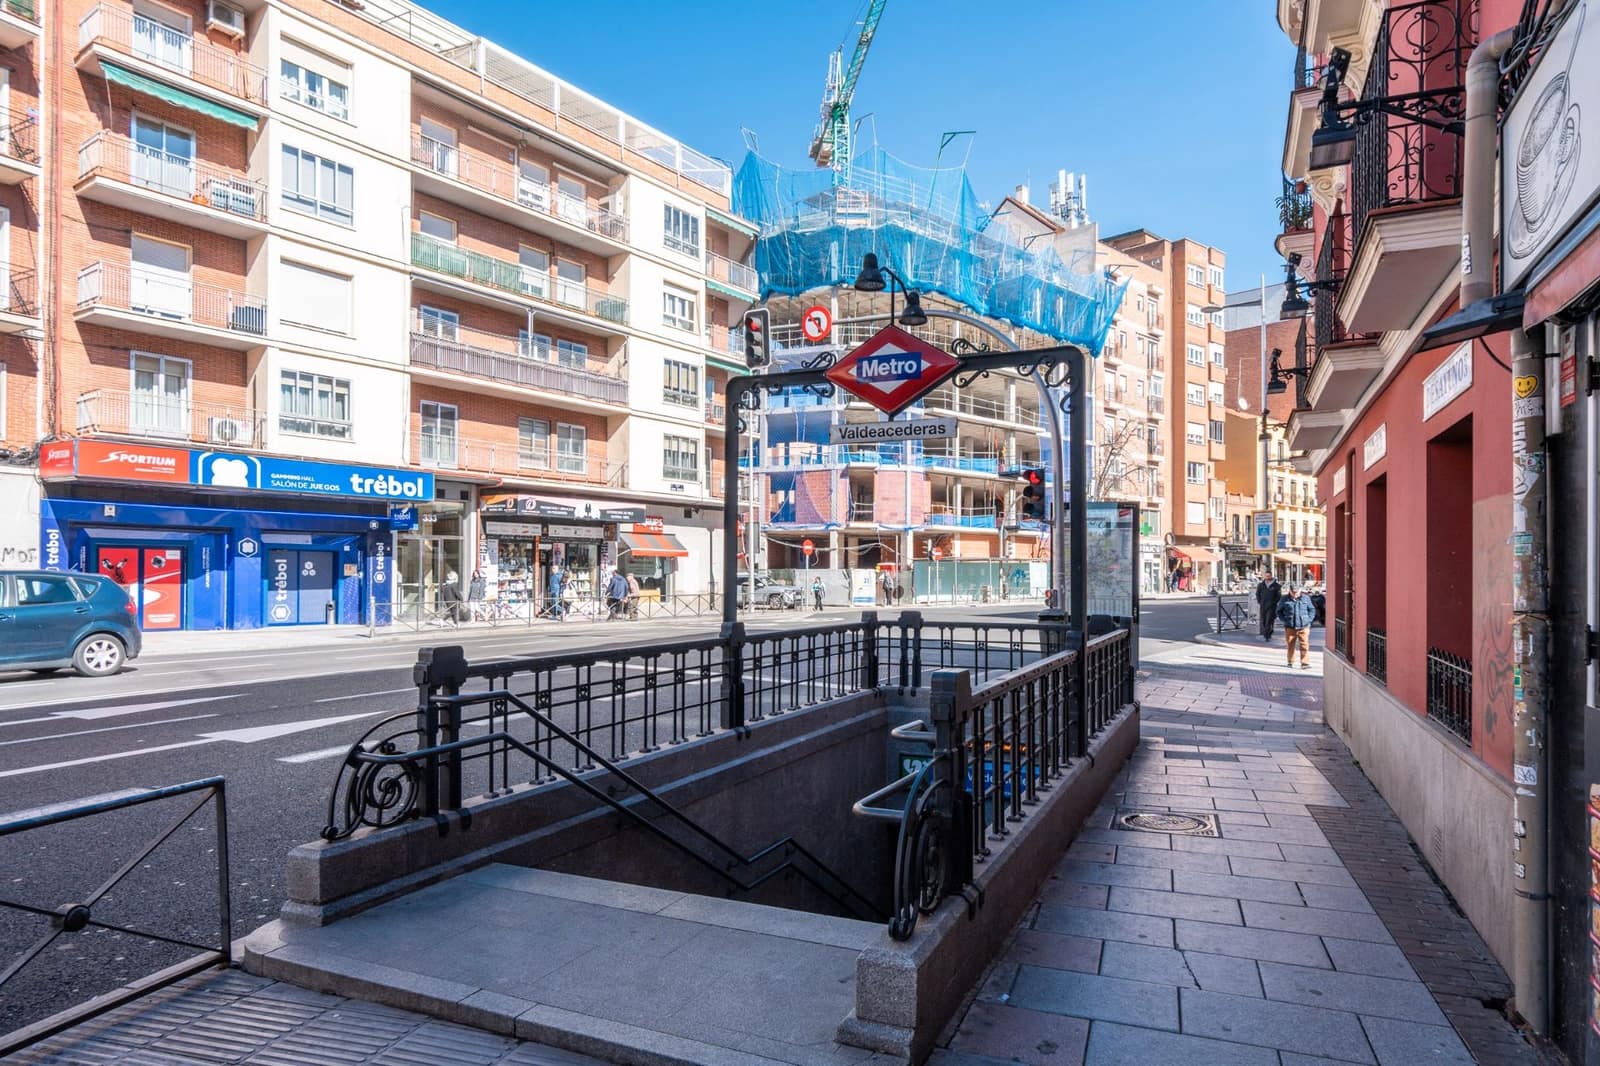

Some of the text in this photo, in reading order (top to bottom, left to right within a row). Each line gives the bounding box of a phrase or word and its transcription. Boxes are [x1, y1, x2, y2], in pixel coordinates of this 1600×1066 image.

[861, 359, 918, 378] Metro
[838, 423, 946, 440] Valdeacederas
[97, 450, 176, 467] SPORTIUM
[271, 479, 340, 492] SALÓN DE JUEGOS
